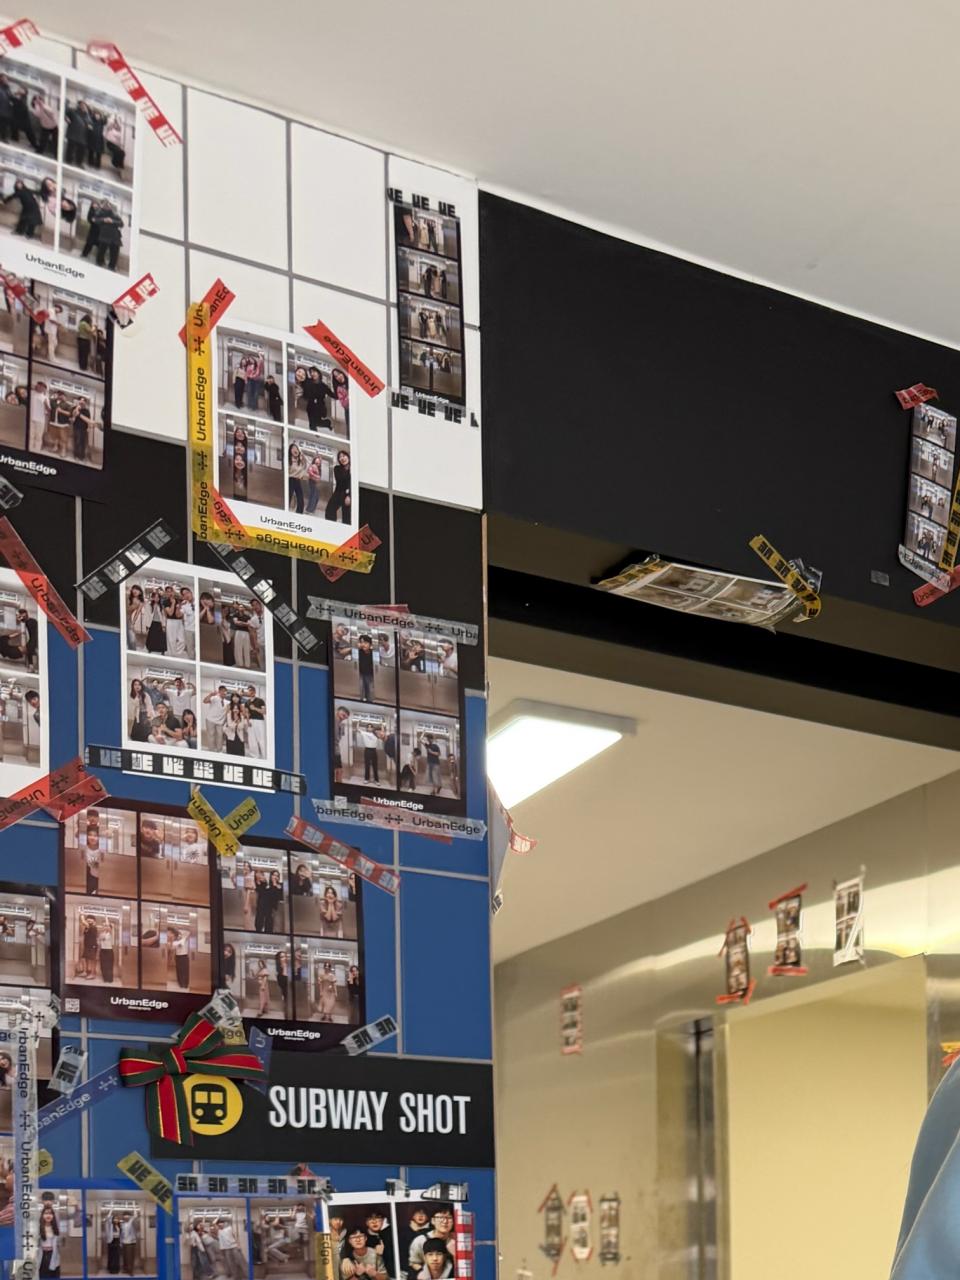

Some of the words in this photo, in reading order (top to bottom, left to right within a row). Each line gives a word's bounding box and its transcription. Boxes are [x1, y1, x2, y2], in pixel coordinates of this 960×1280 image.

[25, 253, 85, 280] UrbanEdge
[196, 367, 208, 442] UrbanEdge
[260, 515, 313, 533] UrbanEdge
[256, 533, 329, 558] UrbanEdge
[344, 608, 415, 629] UrbanEdge
[373, 796, 423, 811] UrbanEdge
[412, 817, 481, 834] UrbanEdge
[110, 996, 169, 1009] UrbanEdge
[268, 1027, 320, 1039] UrbanEdge
[269, 1086, 388, 1130] SUBWAY
[400, 1092, 471, 1134] SHOT
[21, 1142, 32, 1219] UrbanEdge
